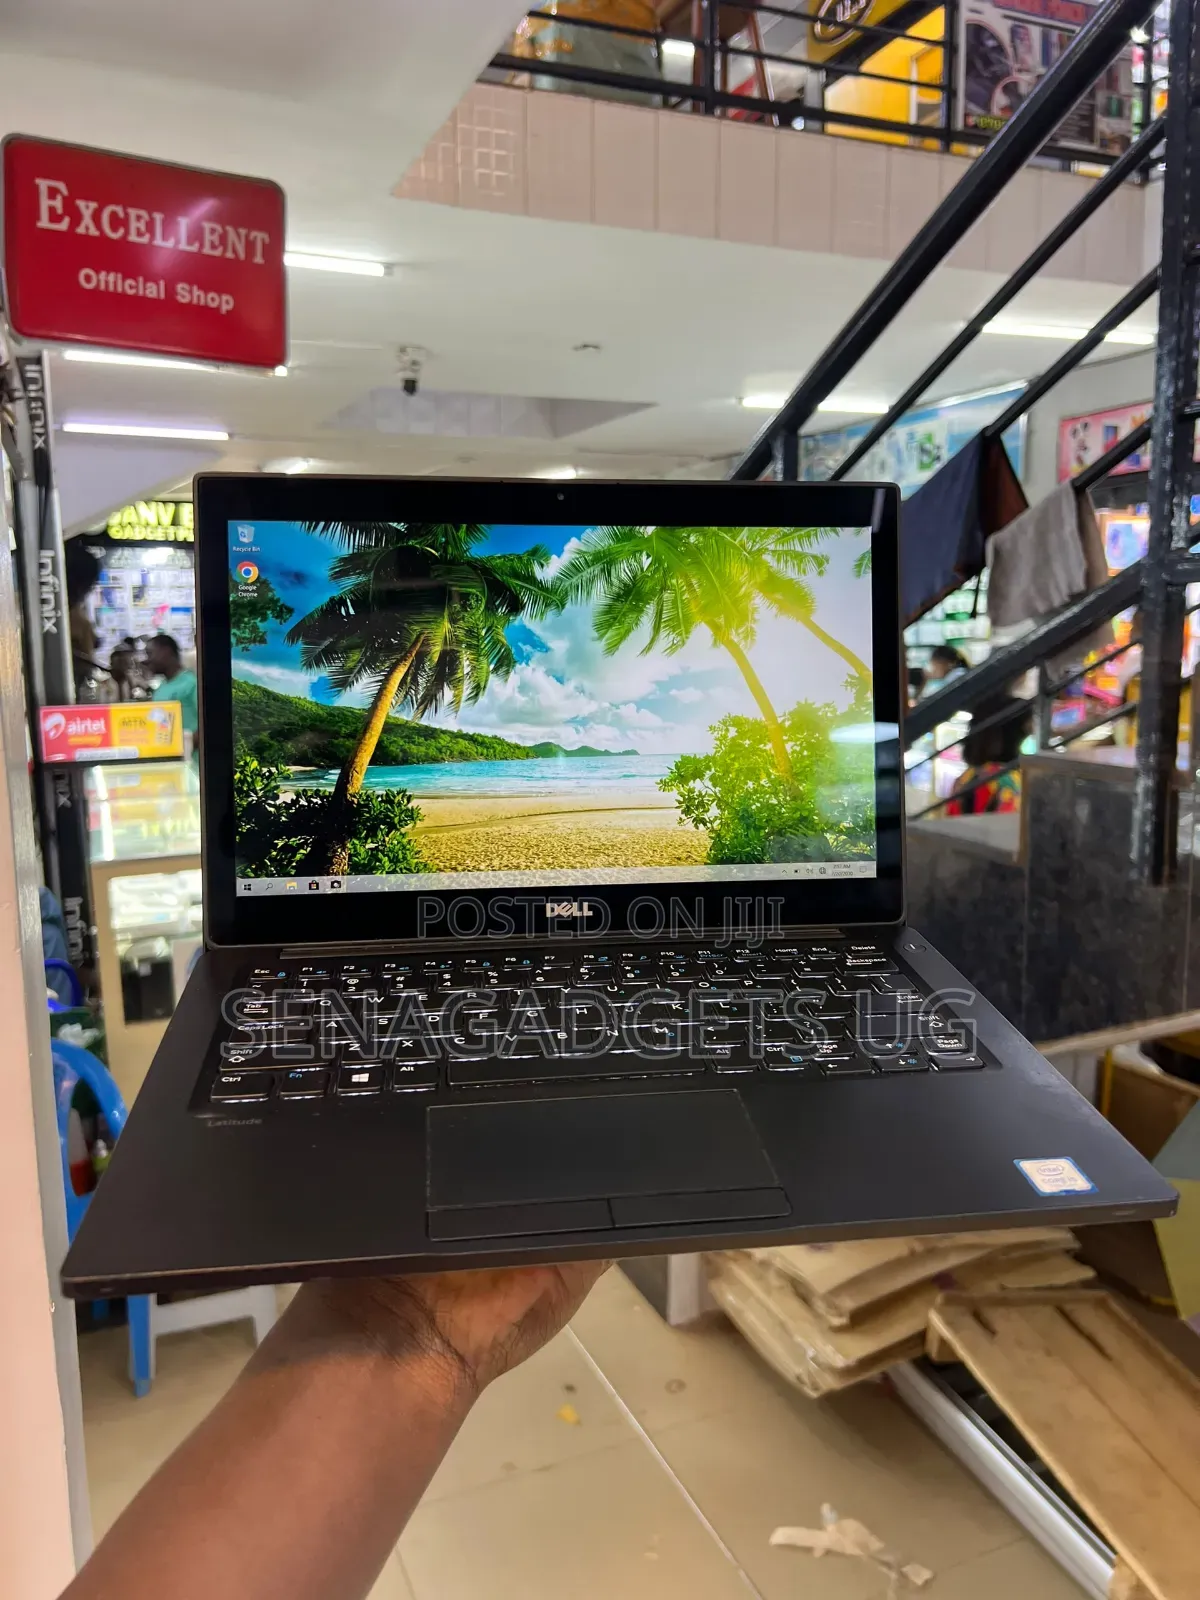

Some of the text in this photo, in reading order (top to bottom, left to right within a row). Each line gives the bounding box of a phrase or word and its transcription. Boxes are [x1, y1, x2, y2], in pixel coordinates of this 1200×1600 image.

[35, 178, 269, 264] EXCELLENT
[78, 267, 234, 314] Official Shop
[40, 549, 62, 634] Infinix
[67, 716, 107, 736] airtel
[546, 902, 593, 917] DELL
[348, 1043, 360, 1051] Z
[207, 1118, 262, 1127] Latitude
